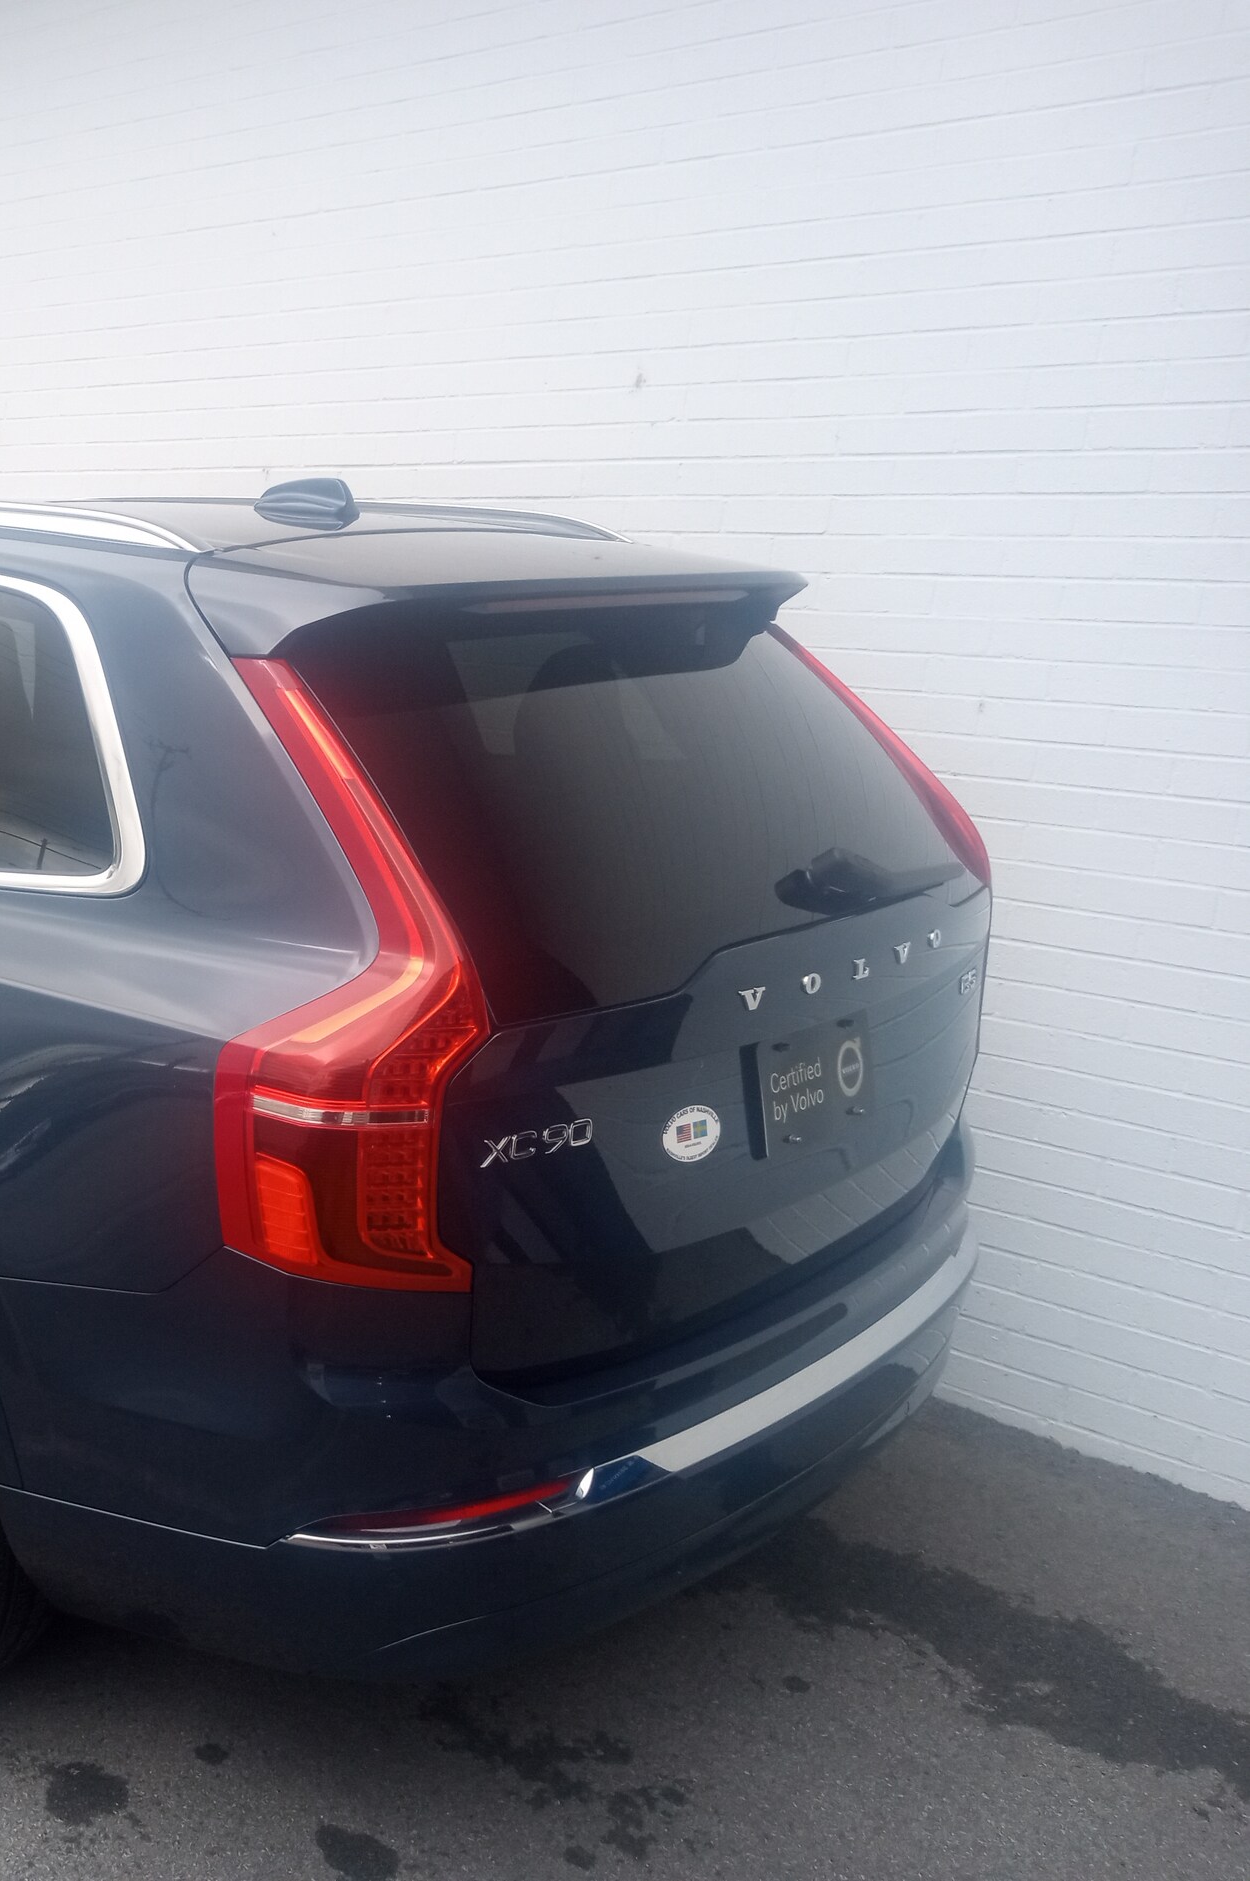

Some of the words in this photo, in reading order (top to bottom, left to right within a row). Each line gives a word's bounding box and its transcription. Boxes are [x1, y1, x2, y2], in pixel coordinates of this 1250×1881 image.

[738, 928, 942, 1011] VOLVO
[770, 1056, 822, 1093] Certified
[773, 1101, 788, 1124] by
[790, 1088, 824, 1113] Volvo
[480, 1118, 593, 1168] XC90
